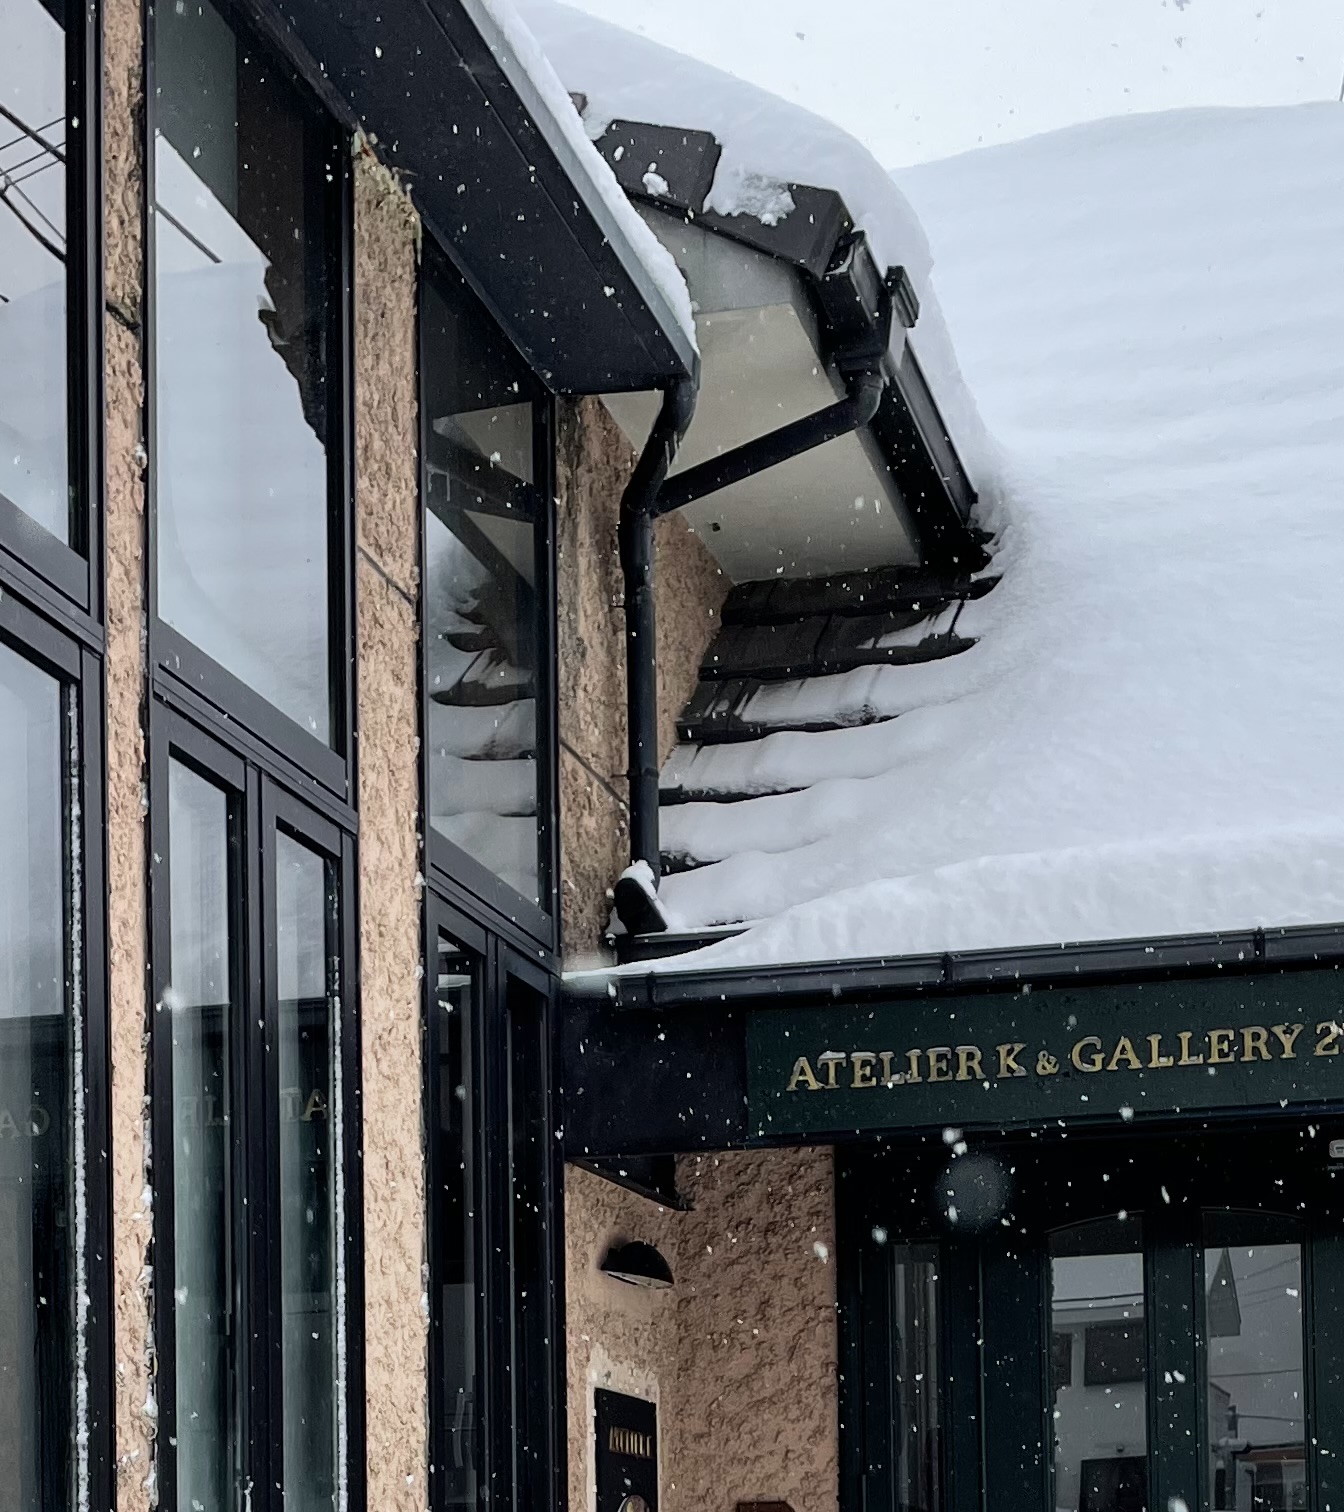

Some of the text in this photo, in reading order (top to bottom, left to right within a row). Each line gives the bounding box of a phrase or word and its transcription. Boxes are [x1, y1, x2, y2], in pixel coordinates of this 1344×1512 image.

[784, 1045, 985, 1092] ATELIER
[997, 1041, 1029, 1079] K
[1034, 1049, 1060, 1077] &
[1067, 1023, 1305, 1073] GALLERY
